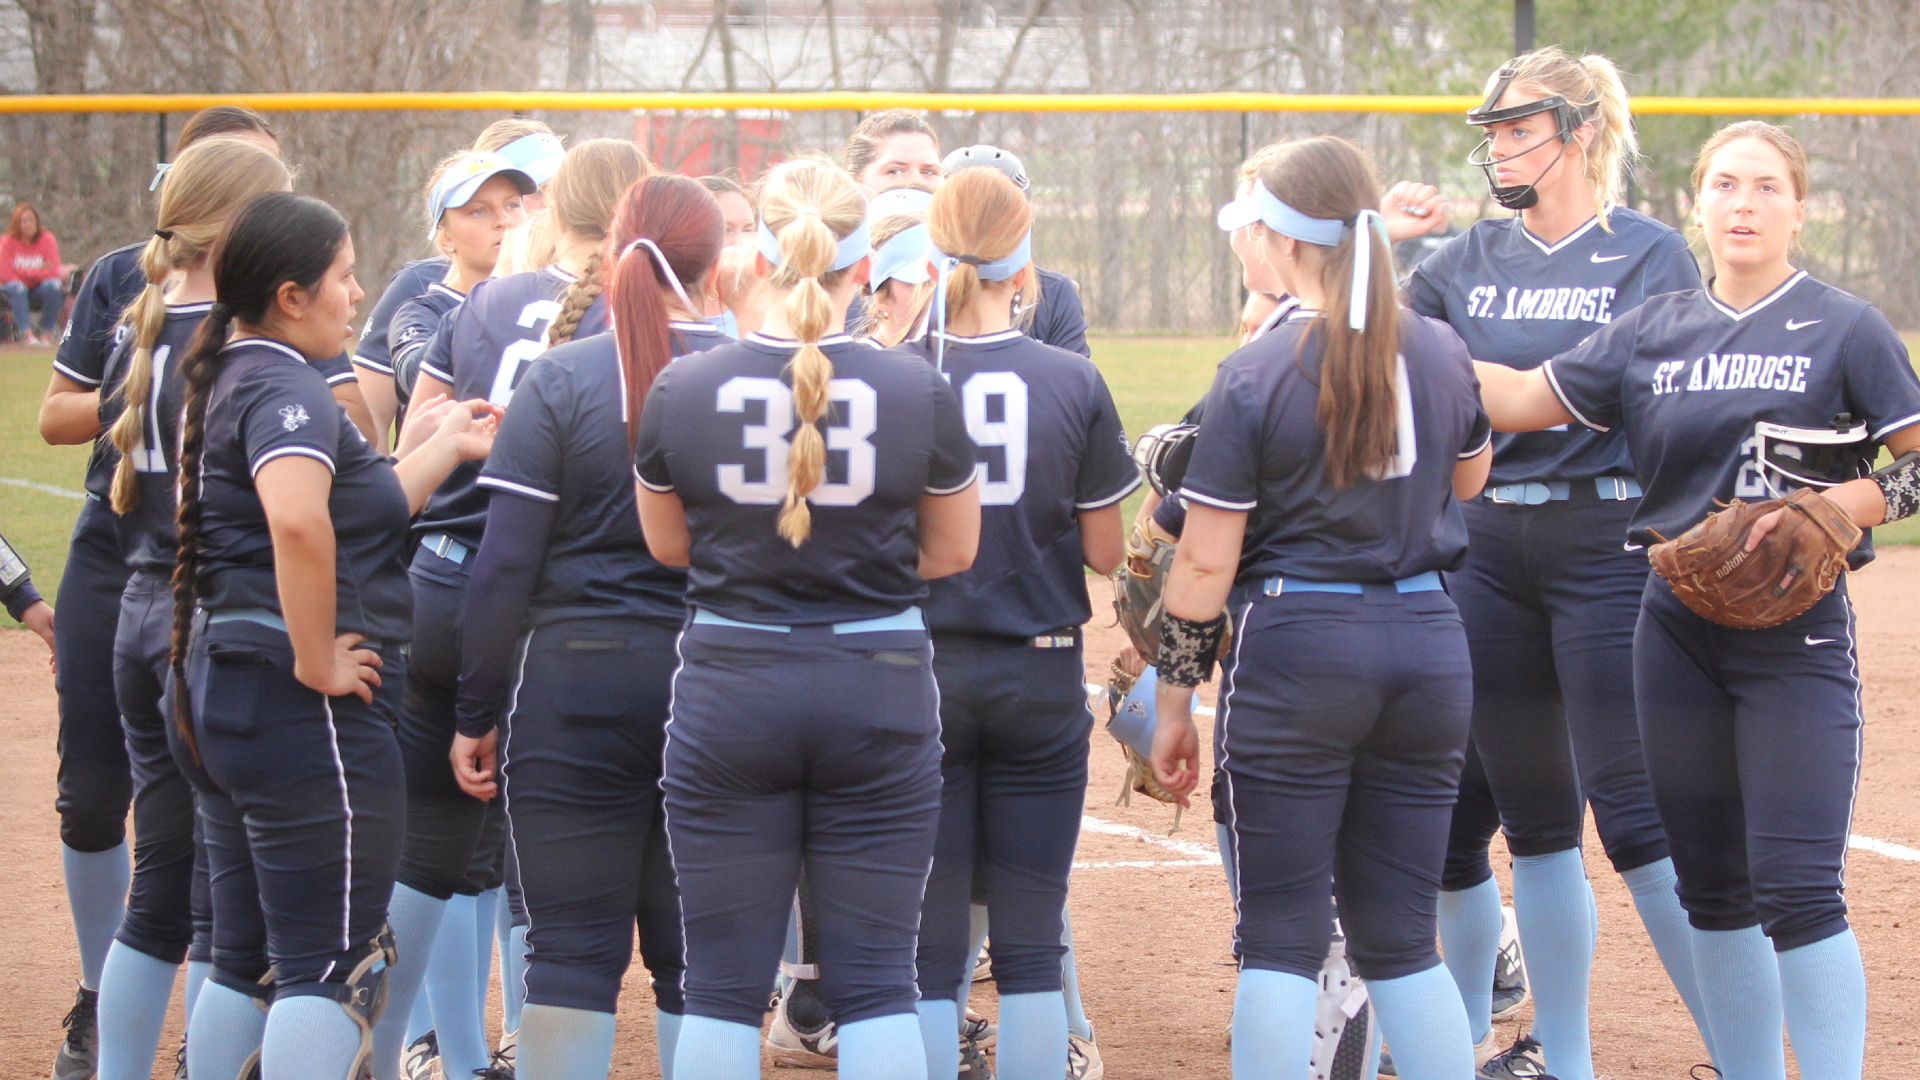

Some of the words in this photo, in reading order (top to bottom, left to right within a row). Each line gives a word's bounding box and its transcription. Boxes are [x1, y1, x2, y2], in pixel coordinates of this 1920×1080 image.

[1467, 285, 1498, 319] ST.
[1501, 286, 1617, 324] AMBROSE
[1652, 360, 1686, 396] ST.
[1687, 353, 1812, 394] AMBROSE
[716, 376, 878, 507] 33
[1716, 550, 1749, 578] nokon
